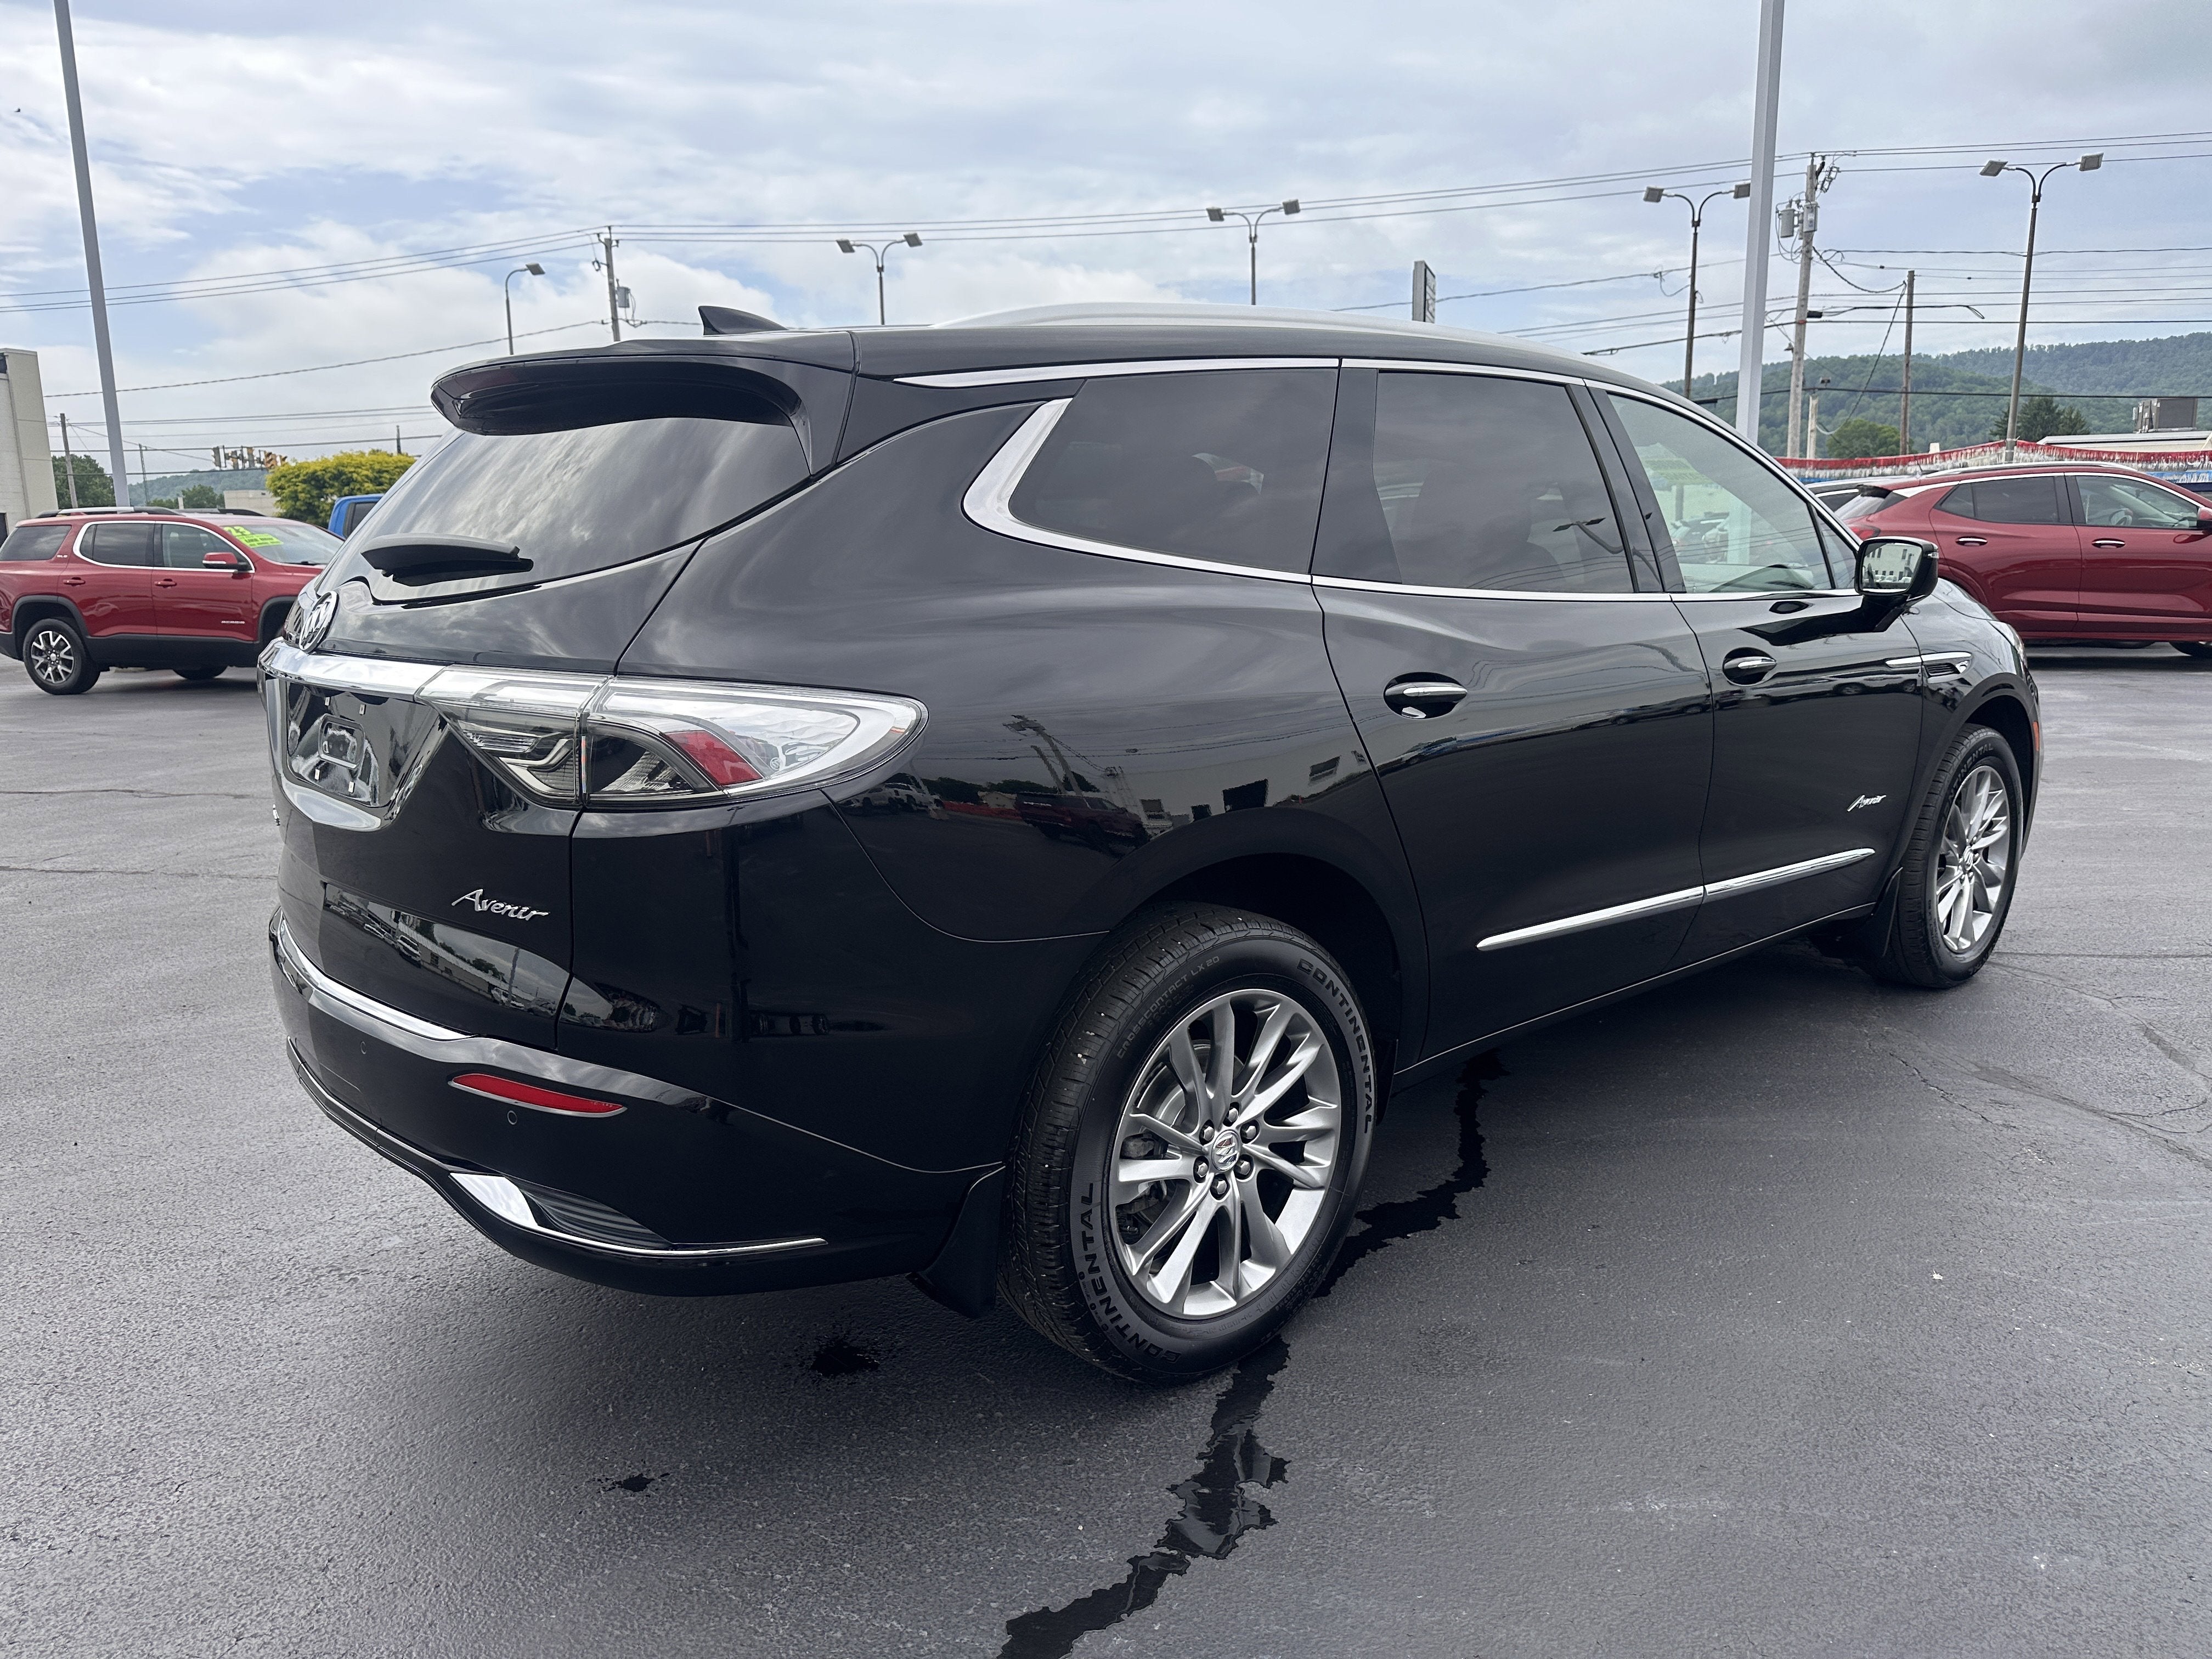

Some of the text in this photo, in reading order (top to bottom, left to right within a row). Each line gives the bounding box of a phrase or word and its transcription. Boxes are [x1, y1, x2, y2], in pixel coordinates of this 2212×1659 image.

[451, 889, 549, 921] Avenir
[1117, 956, 1220, 1059] CROSSCONTACT LX 20
[1296, 958, 1372, 1134] CONTINENTAL
[1081, 1183, 1181, 1363] CONTINENTAL
